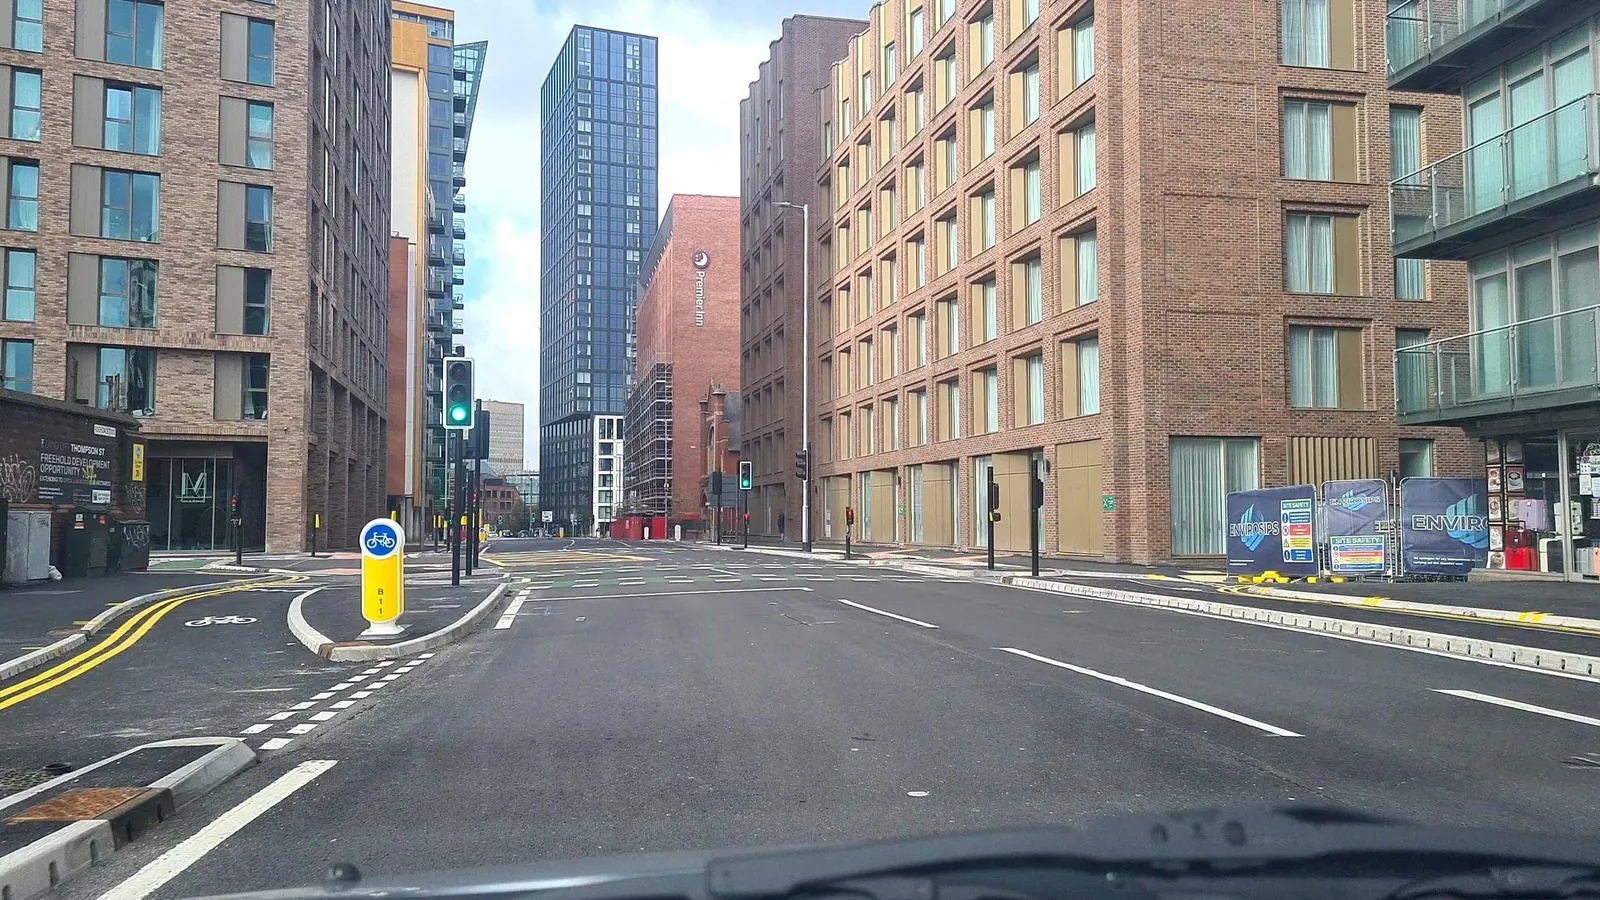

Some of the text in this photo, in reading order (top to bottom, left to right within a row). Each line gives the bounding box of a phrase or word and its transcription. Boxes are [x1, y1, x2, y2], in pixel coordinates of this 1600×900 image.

[696, 271, 706, 326] Premier Inn
[71, 443, 99, 456] THOMPSON
[99, 447, 105, 456] ST
[40, 453, 110, 469] FREEHOLD DEVELOPMENT
[40, 463, 80, 476] OPPORTUNITY
[1329, 495, 1381, 506] ENVIROSIPS
[1229, 521, 1279, 537] ENVIROSIPS
